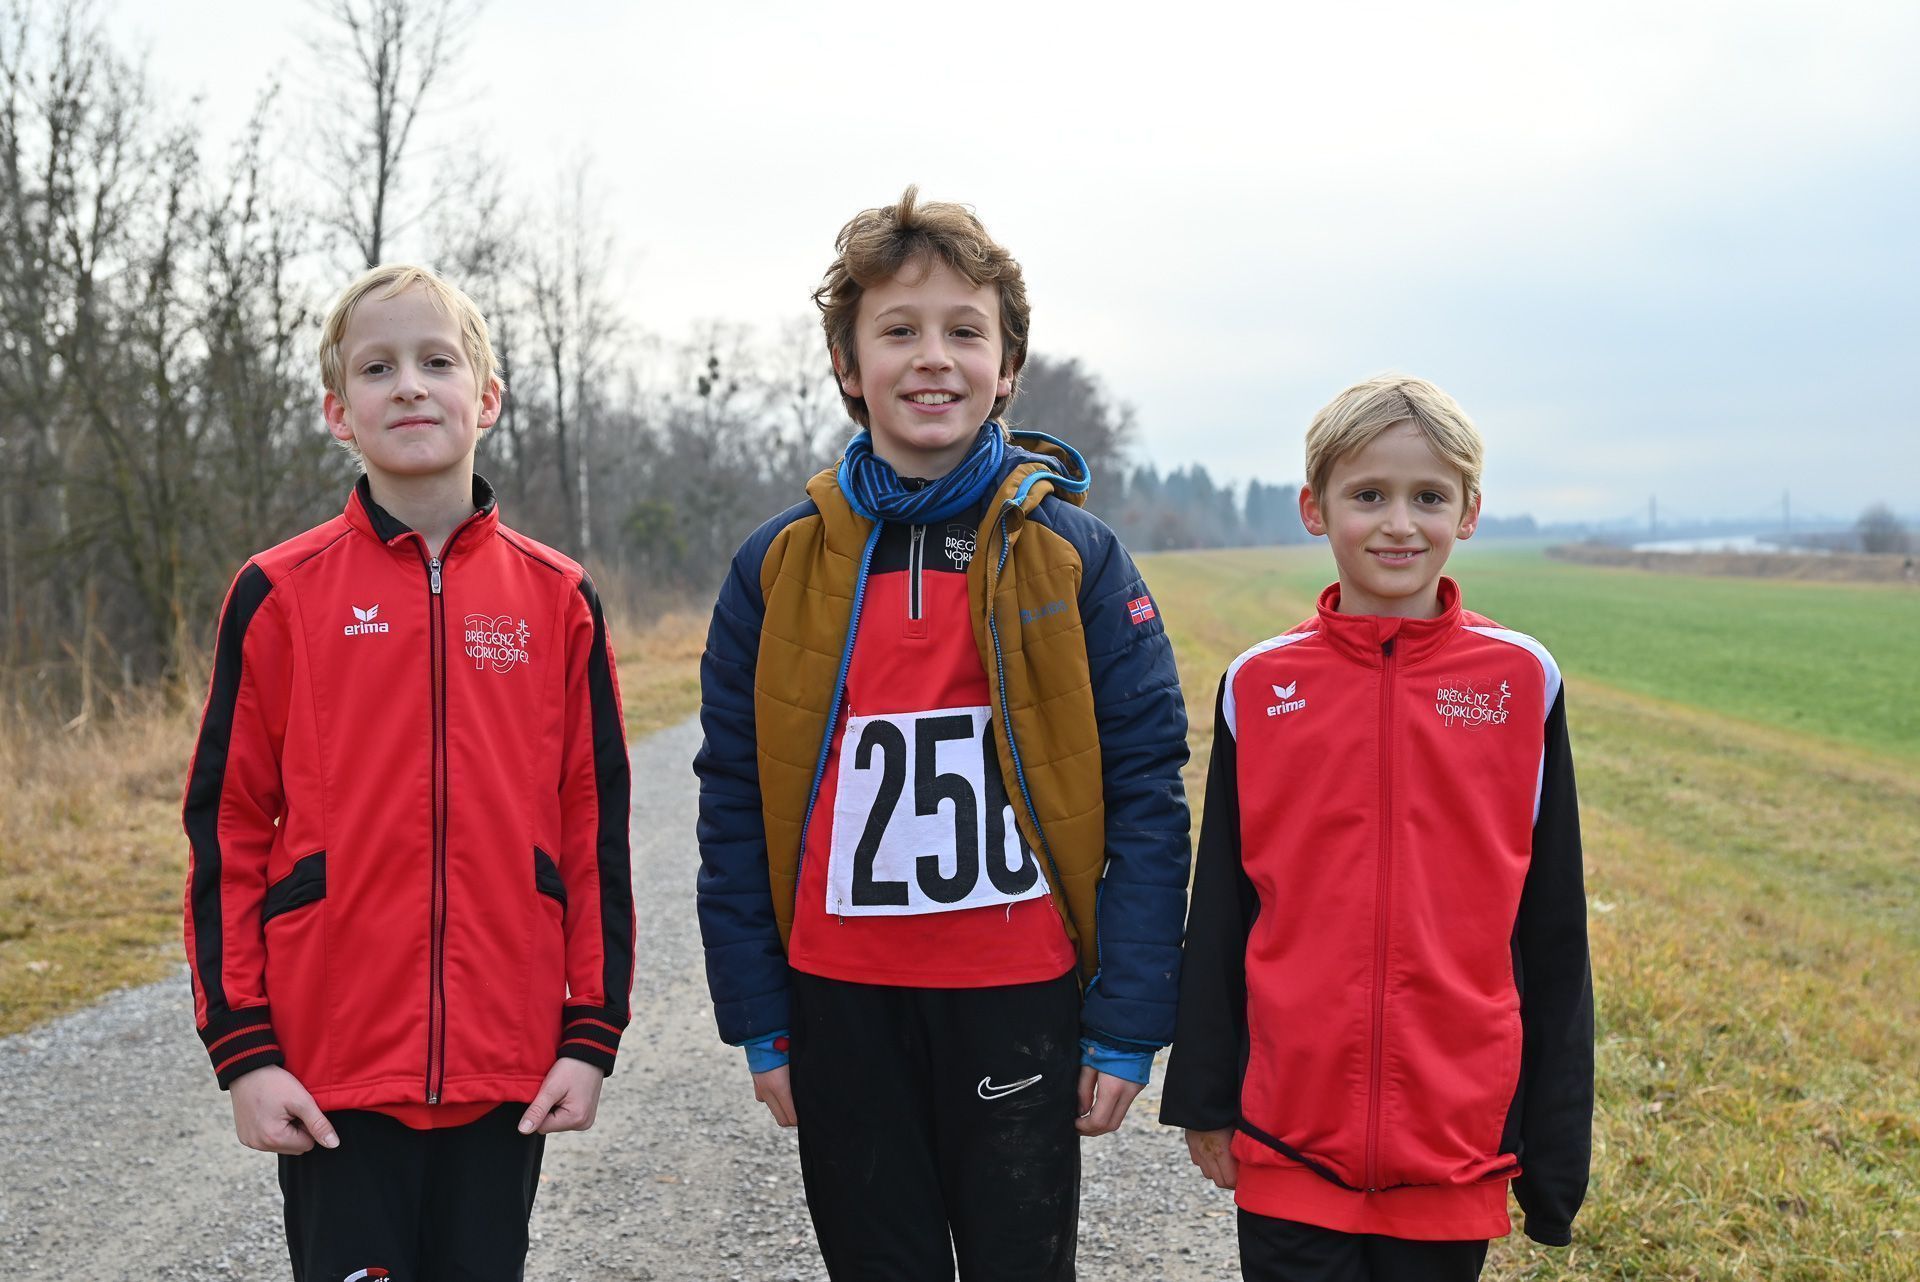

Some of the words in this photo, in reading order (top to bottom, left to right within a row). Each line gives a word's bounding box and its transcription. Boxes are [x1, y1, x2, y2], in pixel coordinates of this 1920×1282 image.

[945, 536, 977, 552] BREG
[344, 621, 389, 636] erima
[465, 630, 515, 646] BREGENZ
[1436, 688, 1491, 707] BREGENZ
[1266, 698, 1306, 717] erima
[1435, 703, 1508, 725] VORKLOSTER
